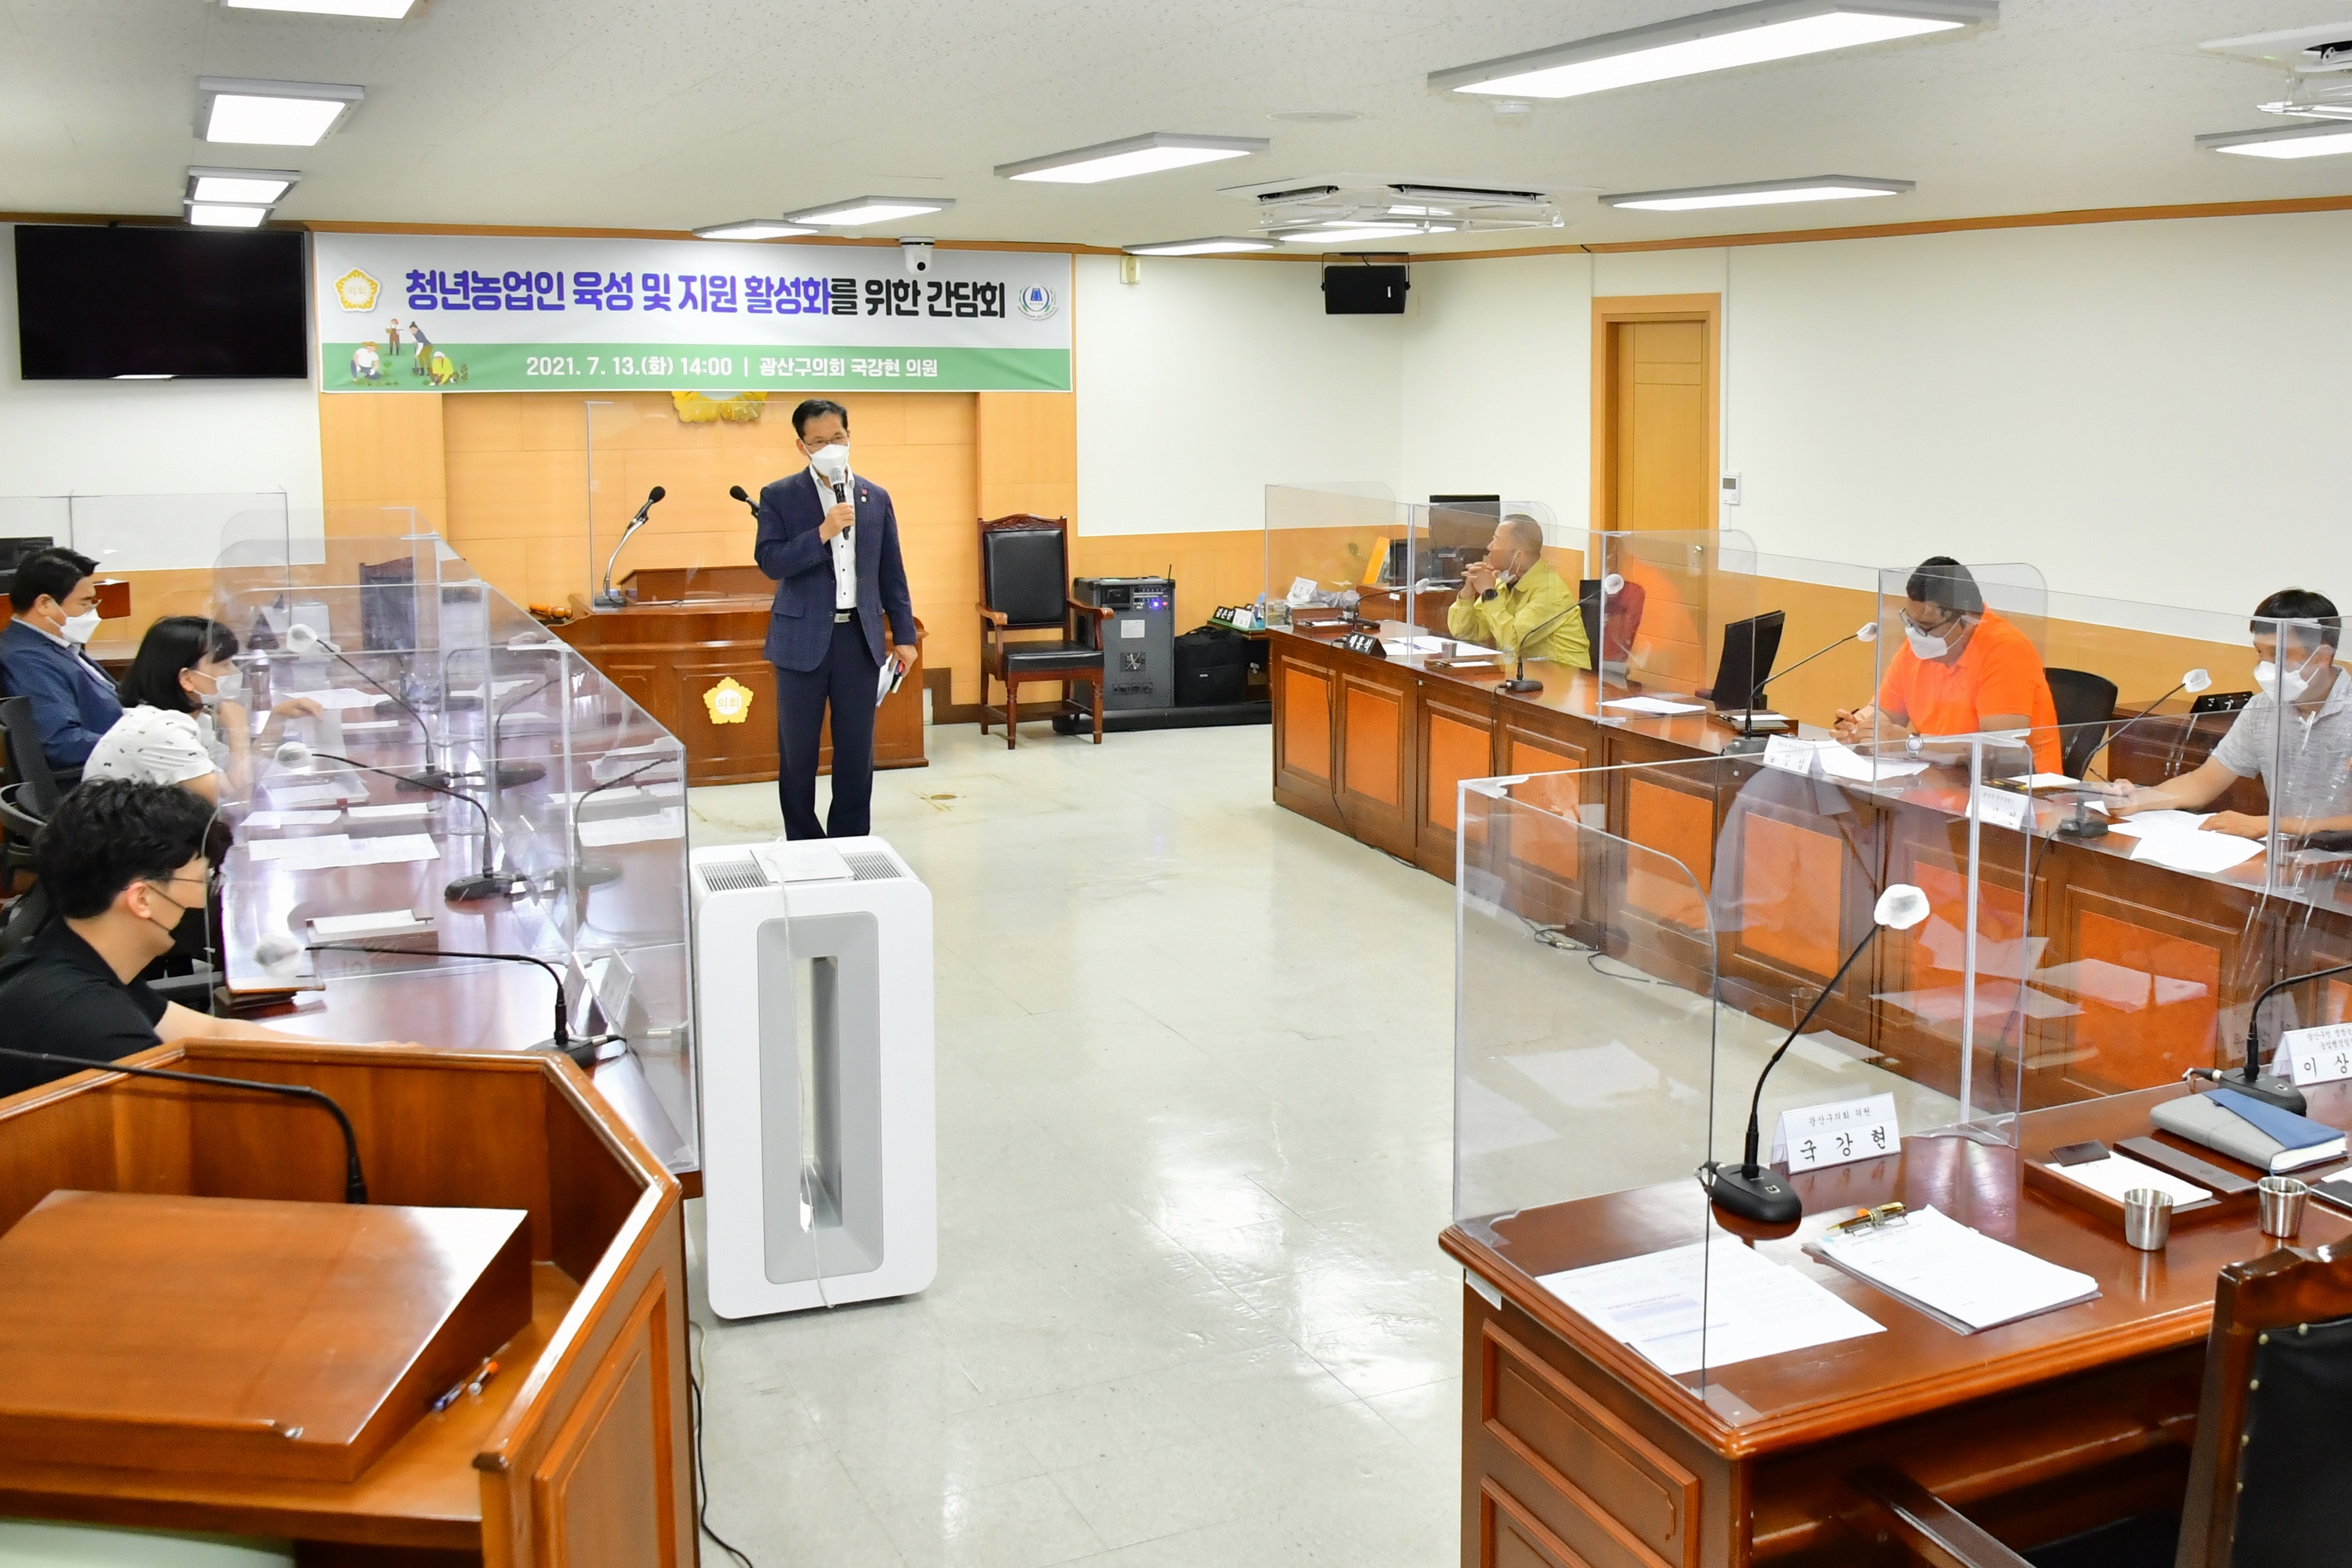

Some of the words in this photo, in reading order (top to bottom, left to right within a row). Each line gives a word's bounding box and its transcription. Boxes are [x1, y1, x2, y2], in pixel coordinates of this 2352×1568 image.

[348, 286, 366, 296] 의회
[406, 269, 565, 311] 청년농업인
[573, 271, 633, 311] 육성
[642, 273, 672, 312] 및
[677, 274, 738, 313] 지원
[744, 275, 858, 315] 활성화를
[865, 279, 921, 316] 위한
[927, 280, 1006, 318] 간담회
[527, 356, 581, 376] 2021.
[587, 357, 606, 376] 7.
[613, 356, 674, 376] 13.(화)
[680, 357, 733, 376] 14:00
[759, 357, 845, 377] 광산구의회
[850, 358, 901, 377] 국강현
[906, 358, 938, 377] 의원
[717, 696, 739, 709] 의회
[2320, 1038, 2352, 1050] 농업행정팀
[1808, 1110, 1850, 1127] 광산구의회
[1855, 1106, 1871, 1117] 의원
